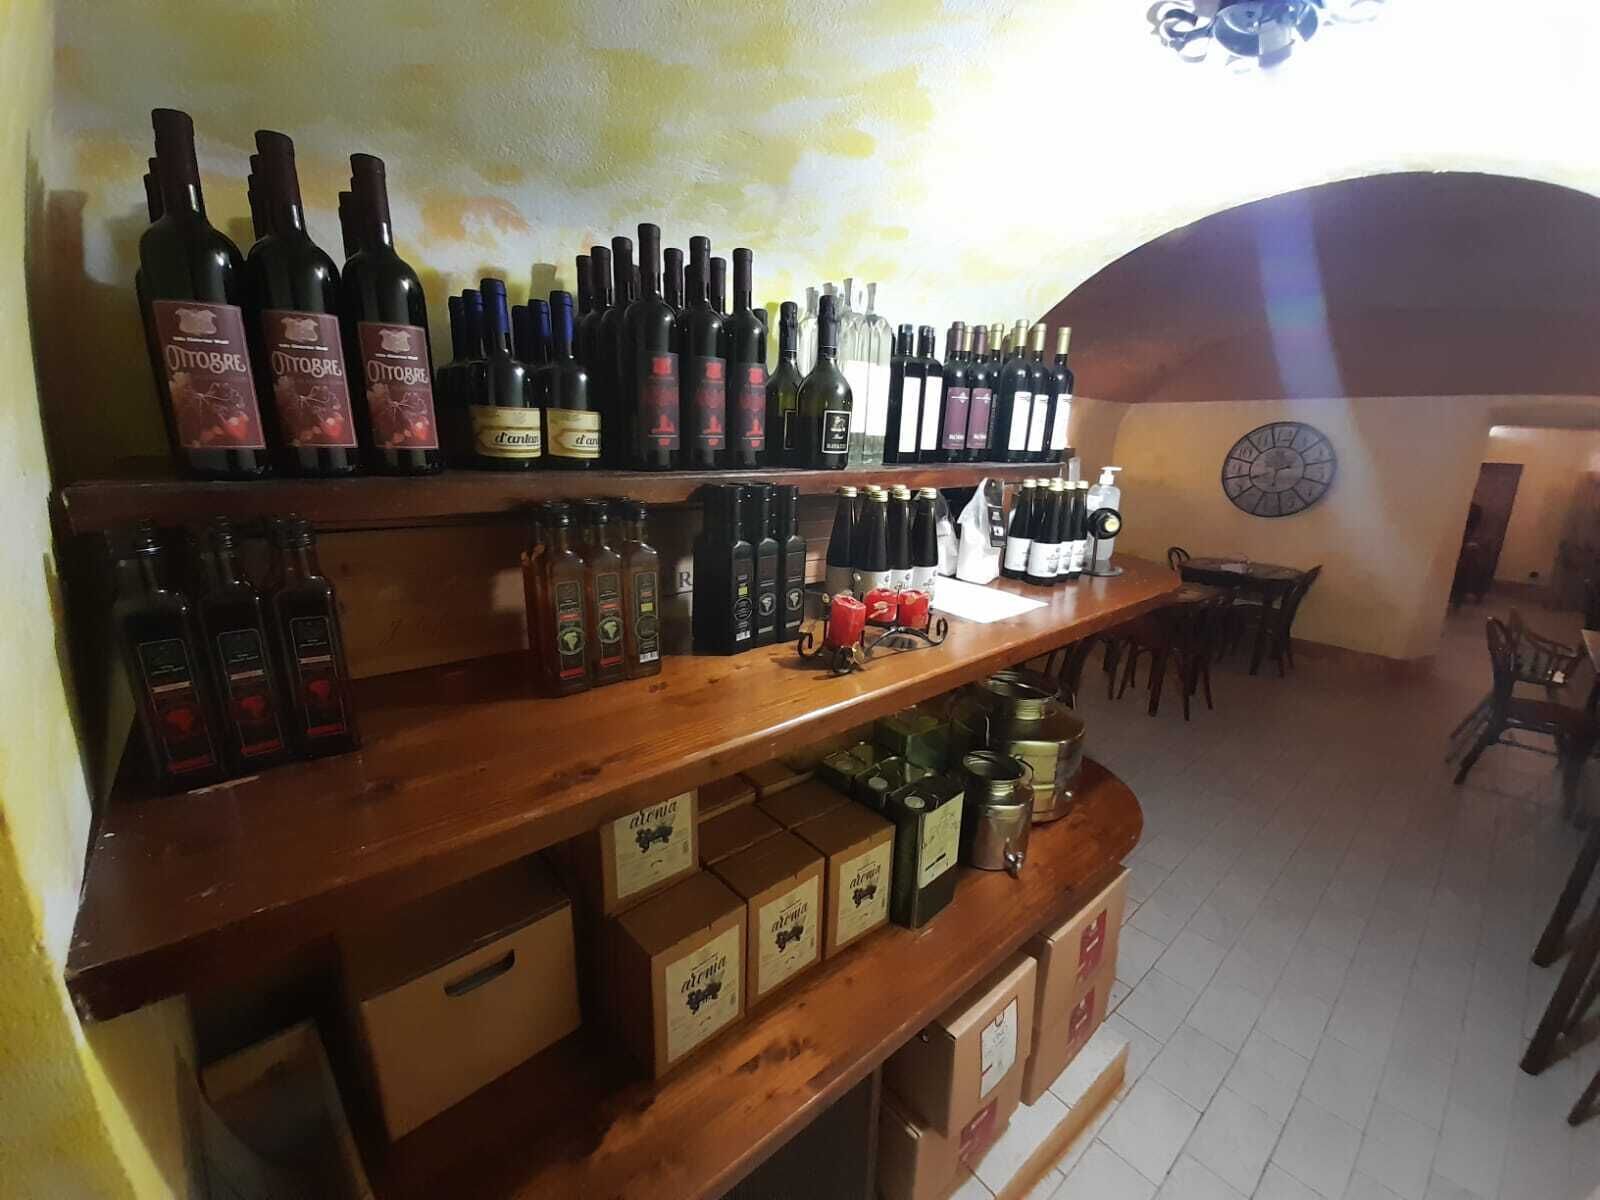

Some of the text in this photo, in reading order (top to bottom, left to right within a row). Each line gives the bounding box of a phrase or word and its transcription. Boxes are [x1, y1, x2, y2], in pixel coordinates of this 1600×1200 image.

[166, 345, 247, 374] OTTOBRE
[271, 350, 342, 378] OTTOBRE
[367, 360, 429, 385] OTTOBRE
[771, 902, 808, 933] aronia
[680, 955, 727, 994] aronia
